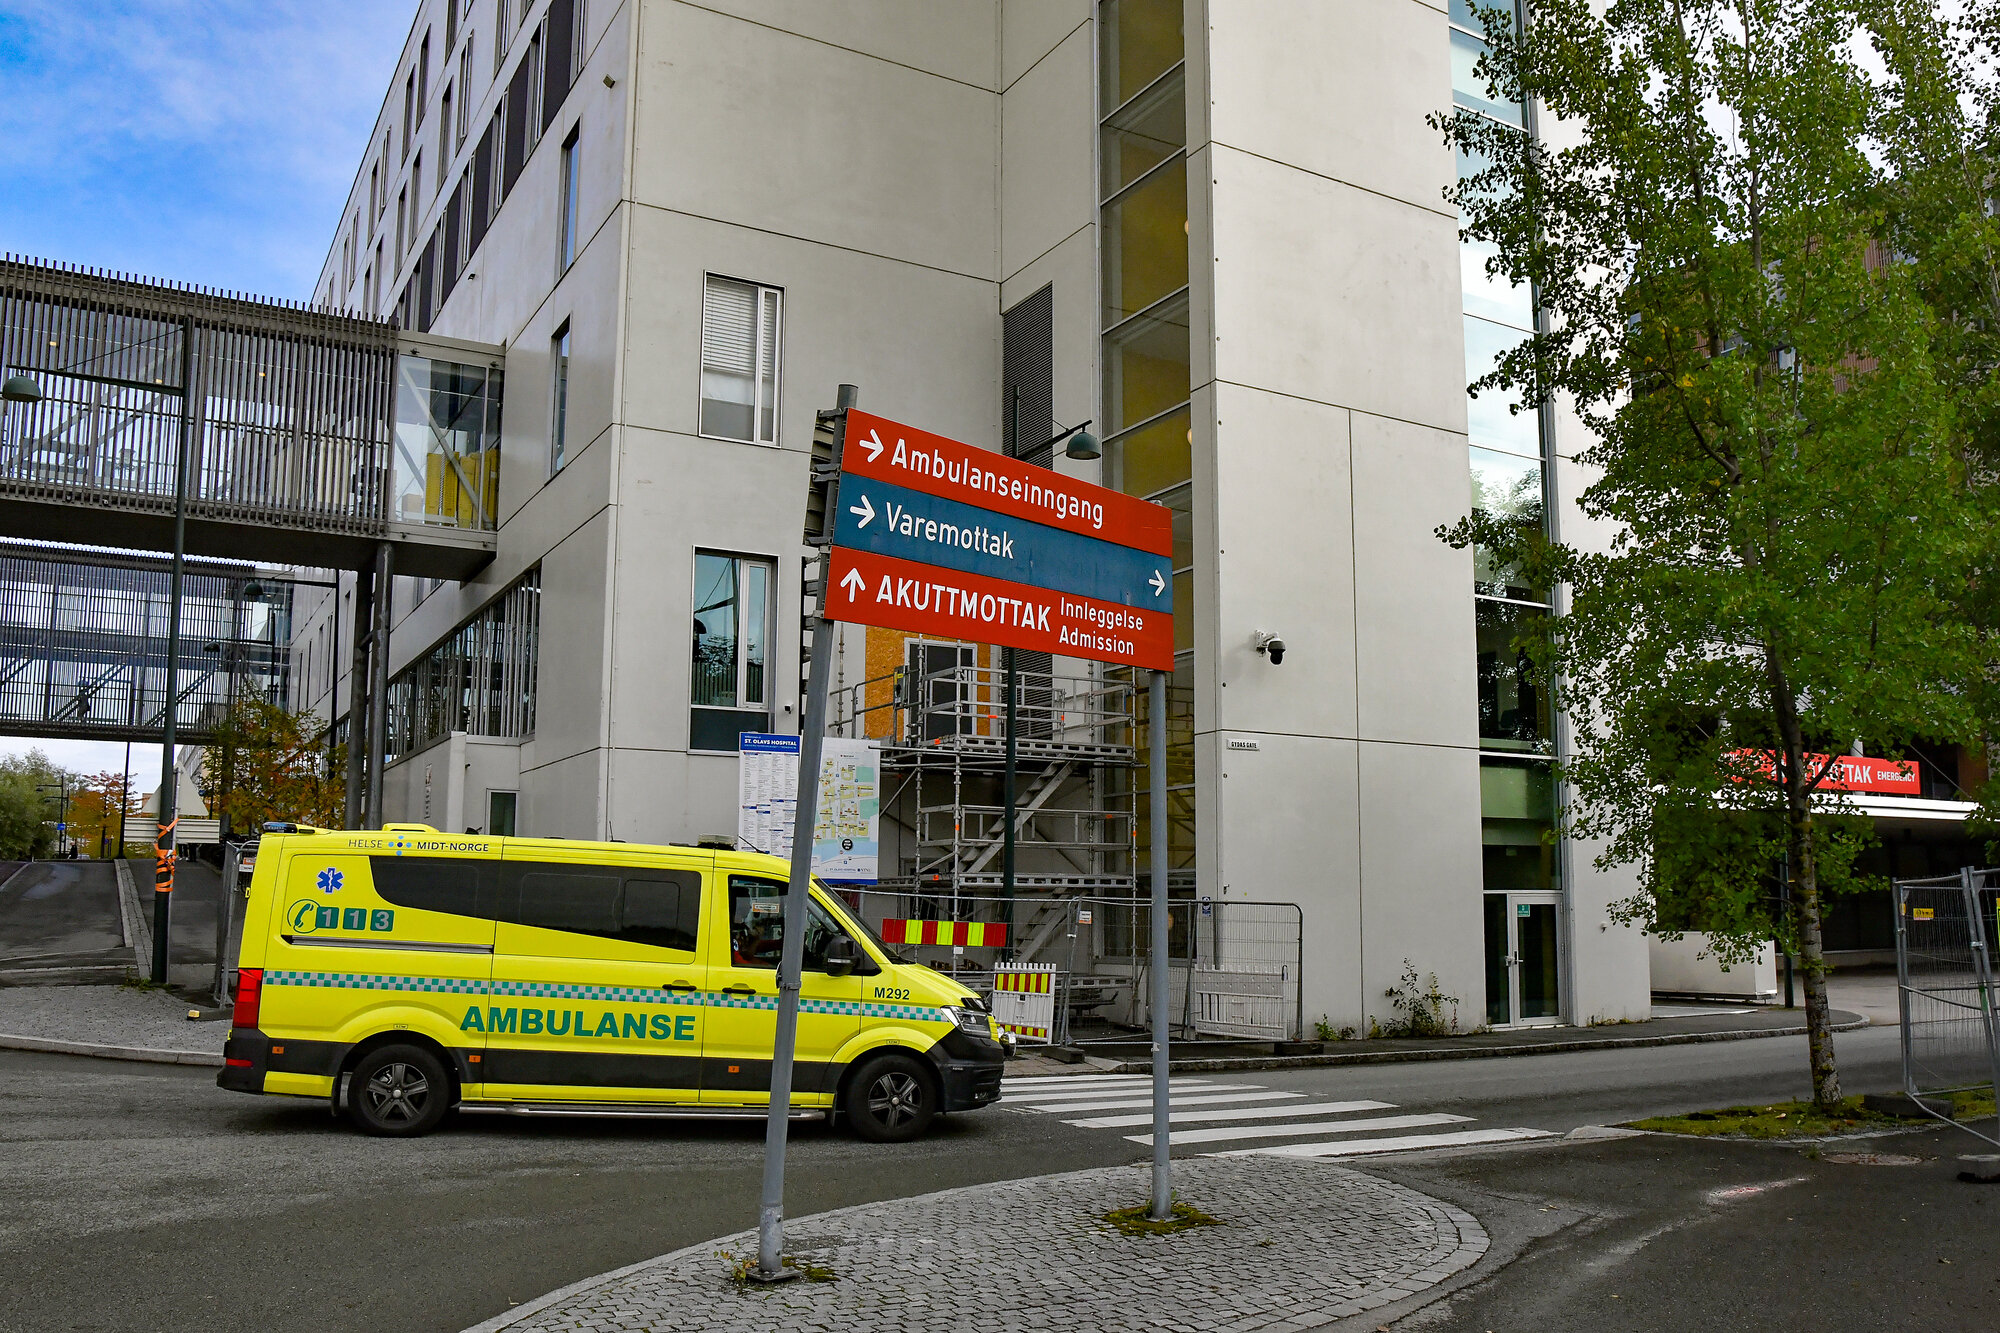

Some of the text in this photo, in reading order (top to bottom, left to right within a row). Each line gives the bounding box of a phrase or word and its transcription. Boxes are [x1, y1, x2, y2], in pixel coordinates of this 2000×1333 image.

[891, 439, 1103, 529] Ambulanseinngang
[886, 502, 1014, 560] Varemottak
[876, 574, 1051, 632] AKUTTMOTTAK
[1060, 597, 1144, 631] Innleggelse
[1059, 625, 1135, 656] Admission
[348, 839, 489, 852] HELSE MIDT-NORGE
[874, 986, 910, 1000] M292
[460, 1005, 696, 1041] AMBULANSE
